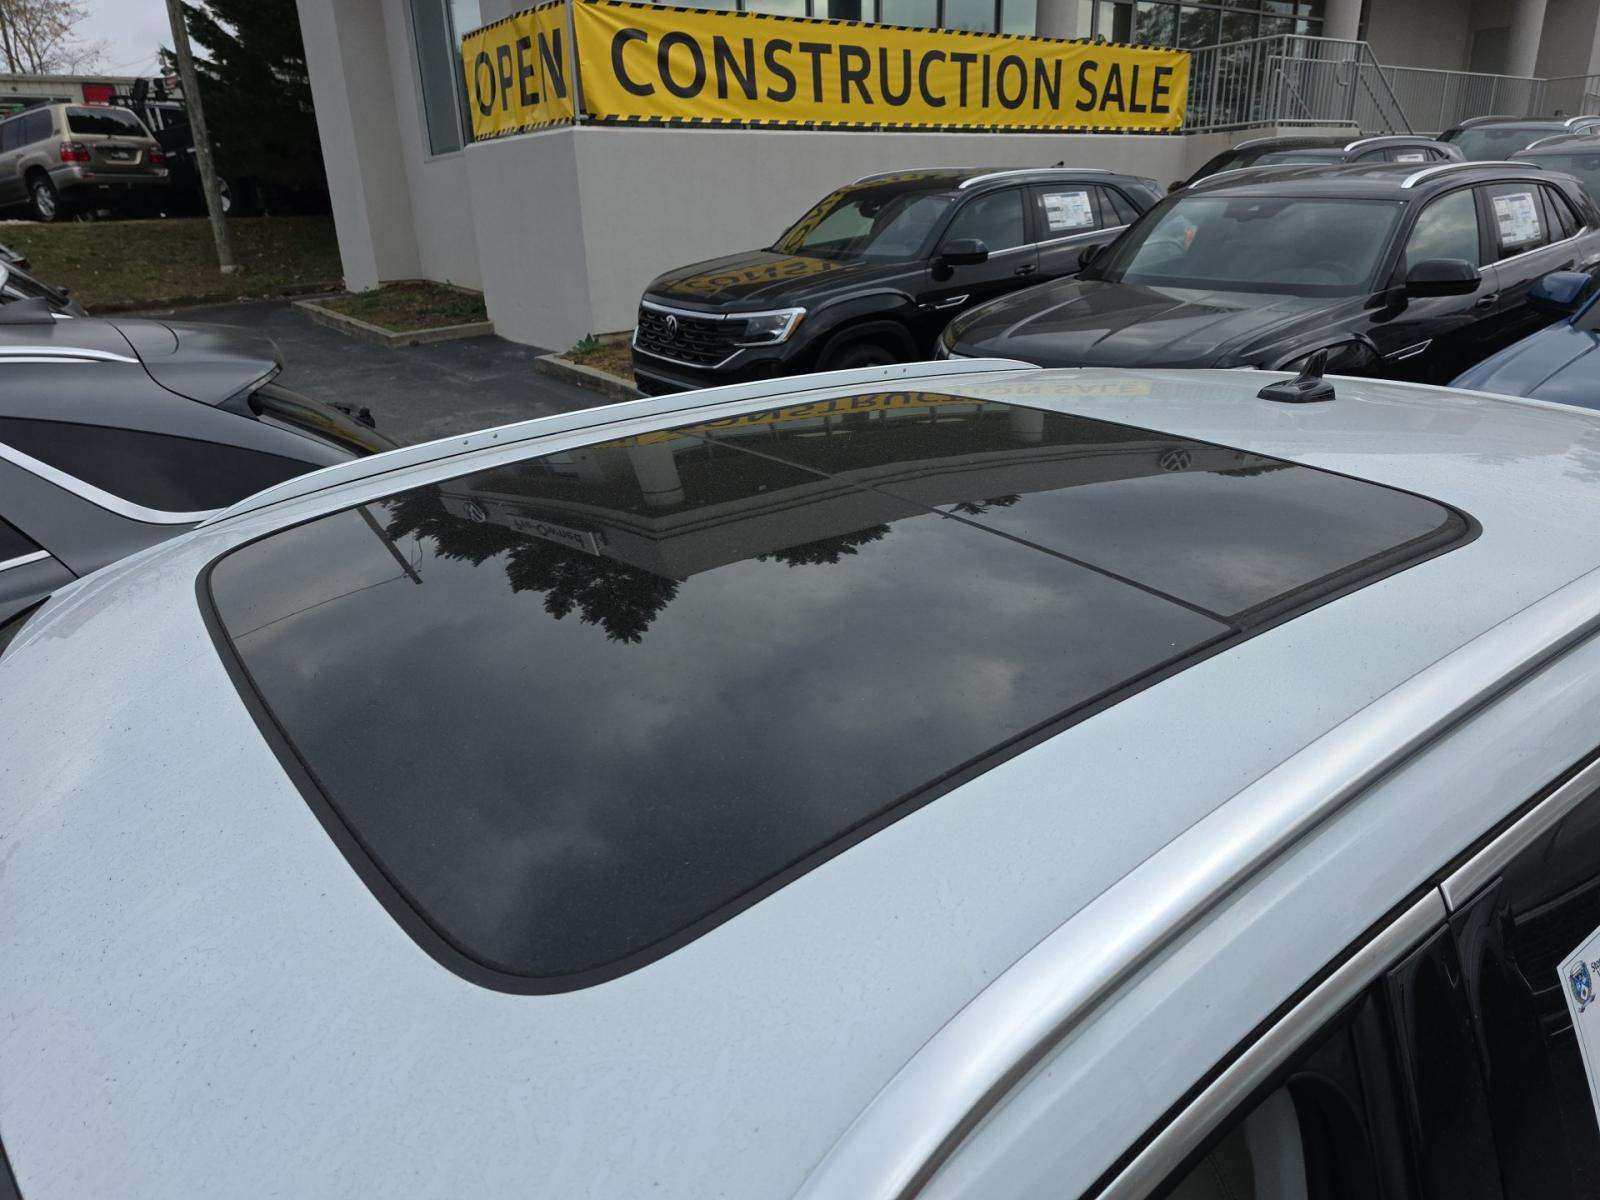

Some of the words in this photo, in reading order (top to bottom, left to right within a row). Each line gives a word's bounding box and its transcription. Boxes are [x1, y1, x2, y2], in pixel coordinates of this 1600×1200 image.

[474, 28, 567, 117] OPEN
[611, 28, 1062, 110] CONSTRUCTION
[1075, 60, 1174, 114] SALE
